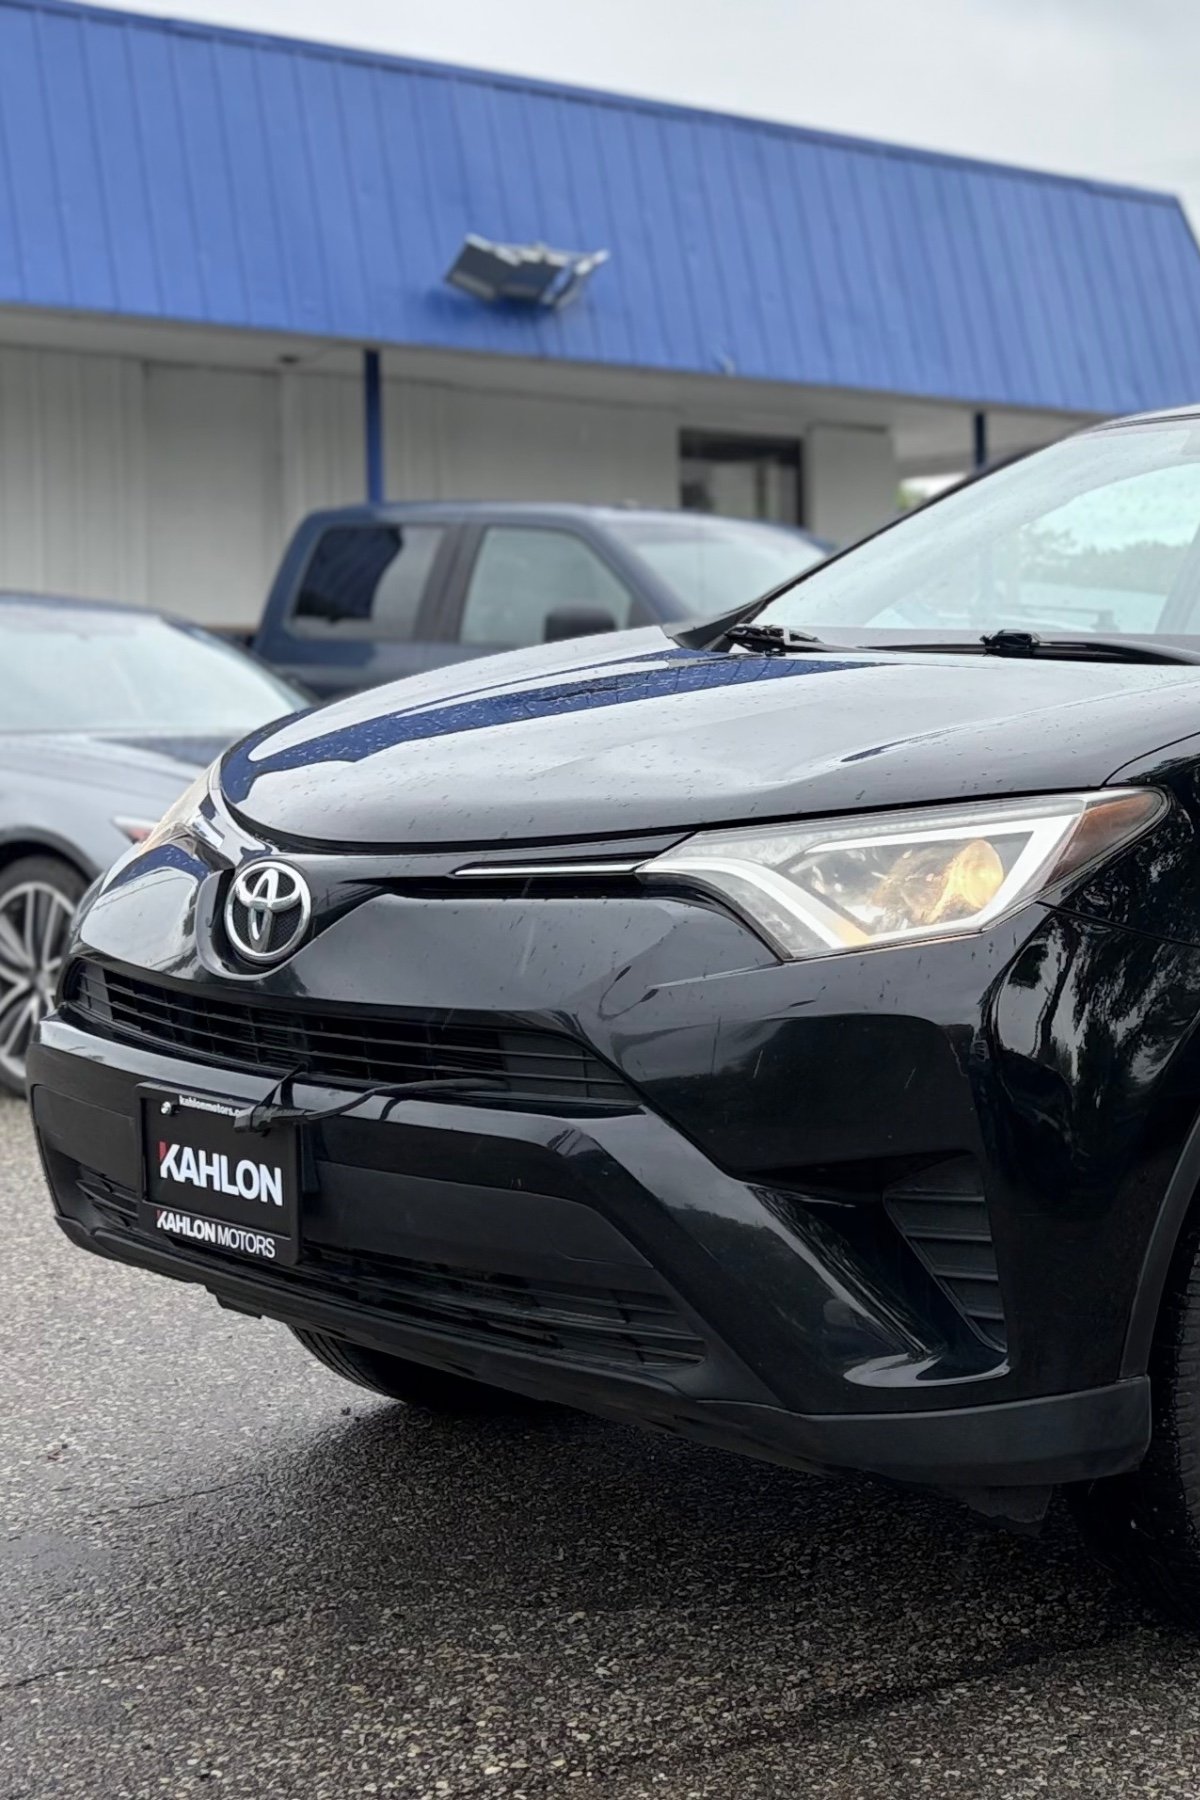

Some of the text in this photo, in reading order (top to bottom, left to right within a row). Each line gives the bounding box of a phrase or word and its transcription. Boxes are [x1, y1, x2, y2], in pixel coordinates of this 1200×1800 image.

[178, 1095, 242, 1117] kahlonmotors.c
[159, 1141, 284, 1206] KAHLON
[156, 1210, 276, 1259] KAHLON MOTORS
